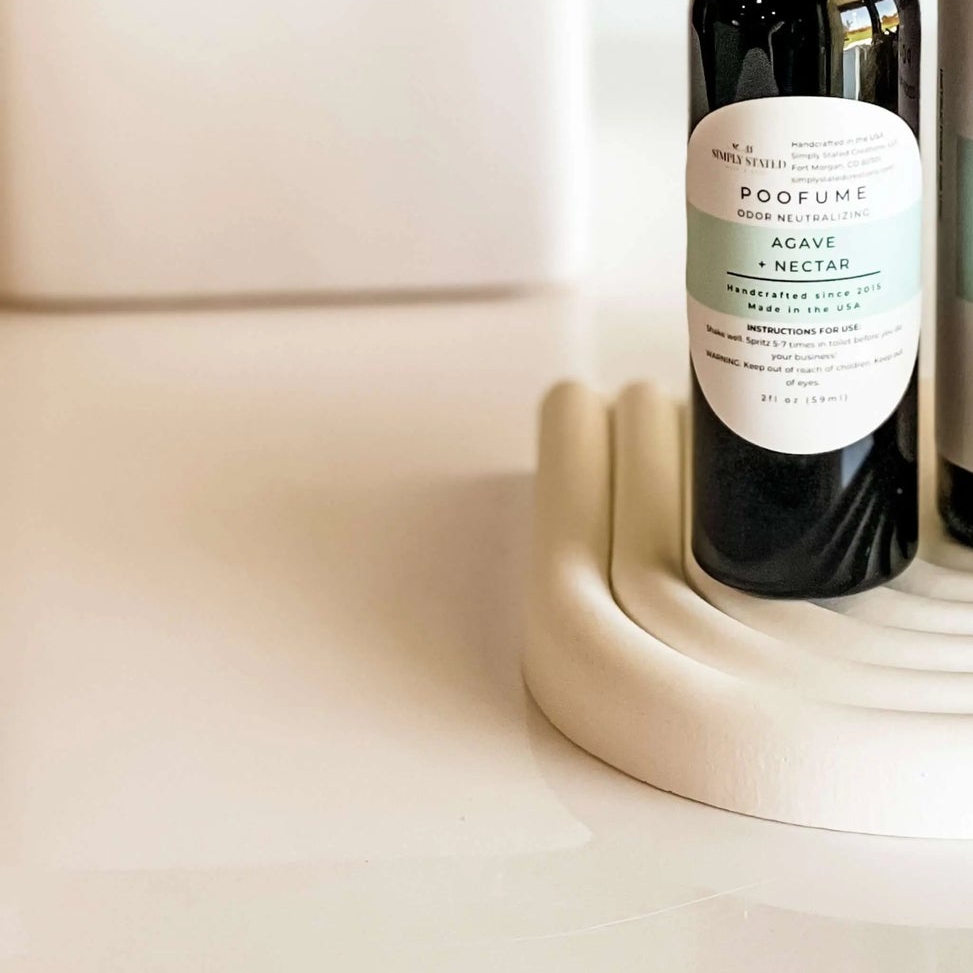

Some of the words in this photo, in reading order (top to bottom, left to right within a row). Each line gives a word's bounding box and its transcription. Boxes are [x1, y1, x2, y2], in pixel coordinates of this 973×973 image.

[791, 139, 844, 148] Handcrafted
[846, 137, 854, 145] in
[791, 152, 820, 160] Simply
[823, 149, 850, 159] Stated
[740, 186, 867, 205] POOFUME
[737, 209, 772, 221] ODOR
[777, 208, 870, 223] NEUTRALIZING
[771, 236, 836, 250] AGAVE
[758, 260, 766, 269] +
[775, 258, 850, 273] NECTAR
[727, 284, 808, 300] Handcrafted
[815, 290, 850, 300] since
[857, 283, 882, 295] 2015
[748, 302, 780, 313] Made
[788, 305, 799, 313] in
[807, 303, 829, 313] the
[837, 302, 861, 312] USA
[747, 324, 816, 336] INSTRUCTIONS
[819, 326, 839, 334] FOR
[746, 337, 770, 347] Spritz
[772, 340, 787, 348] 5-7
[829, 338, 851, 347] toilet
[771, 353, 792, 361] your
[743, 362, 765, 372] Keep
[796, 365, 822, 374] reach
[825, 365, 834, 373] of
[786, 379, 795, 387] of
[761, 393, 777, 404] 2fl
[805, 393, 848, 405] (59ml)
